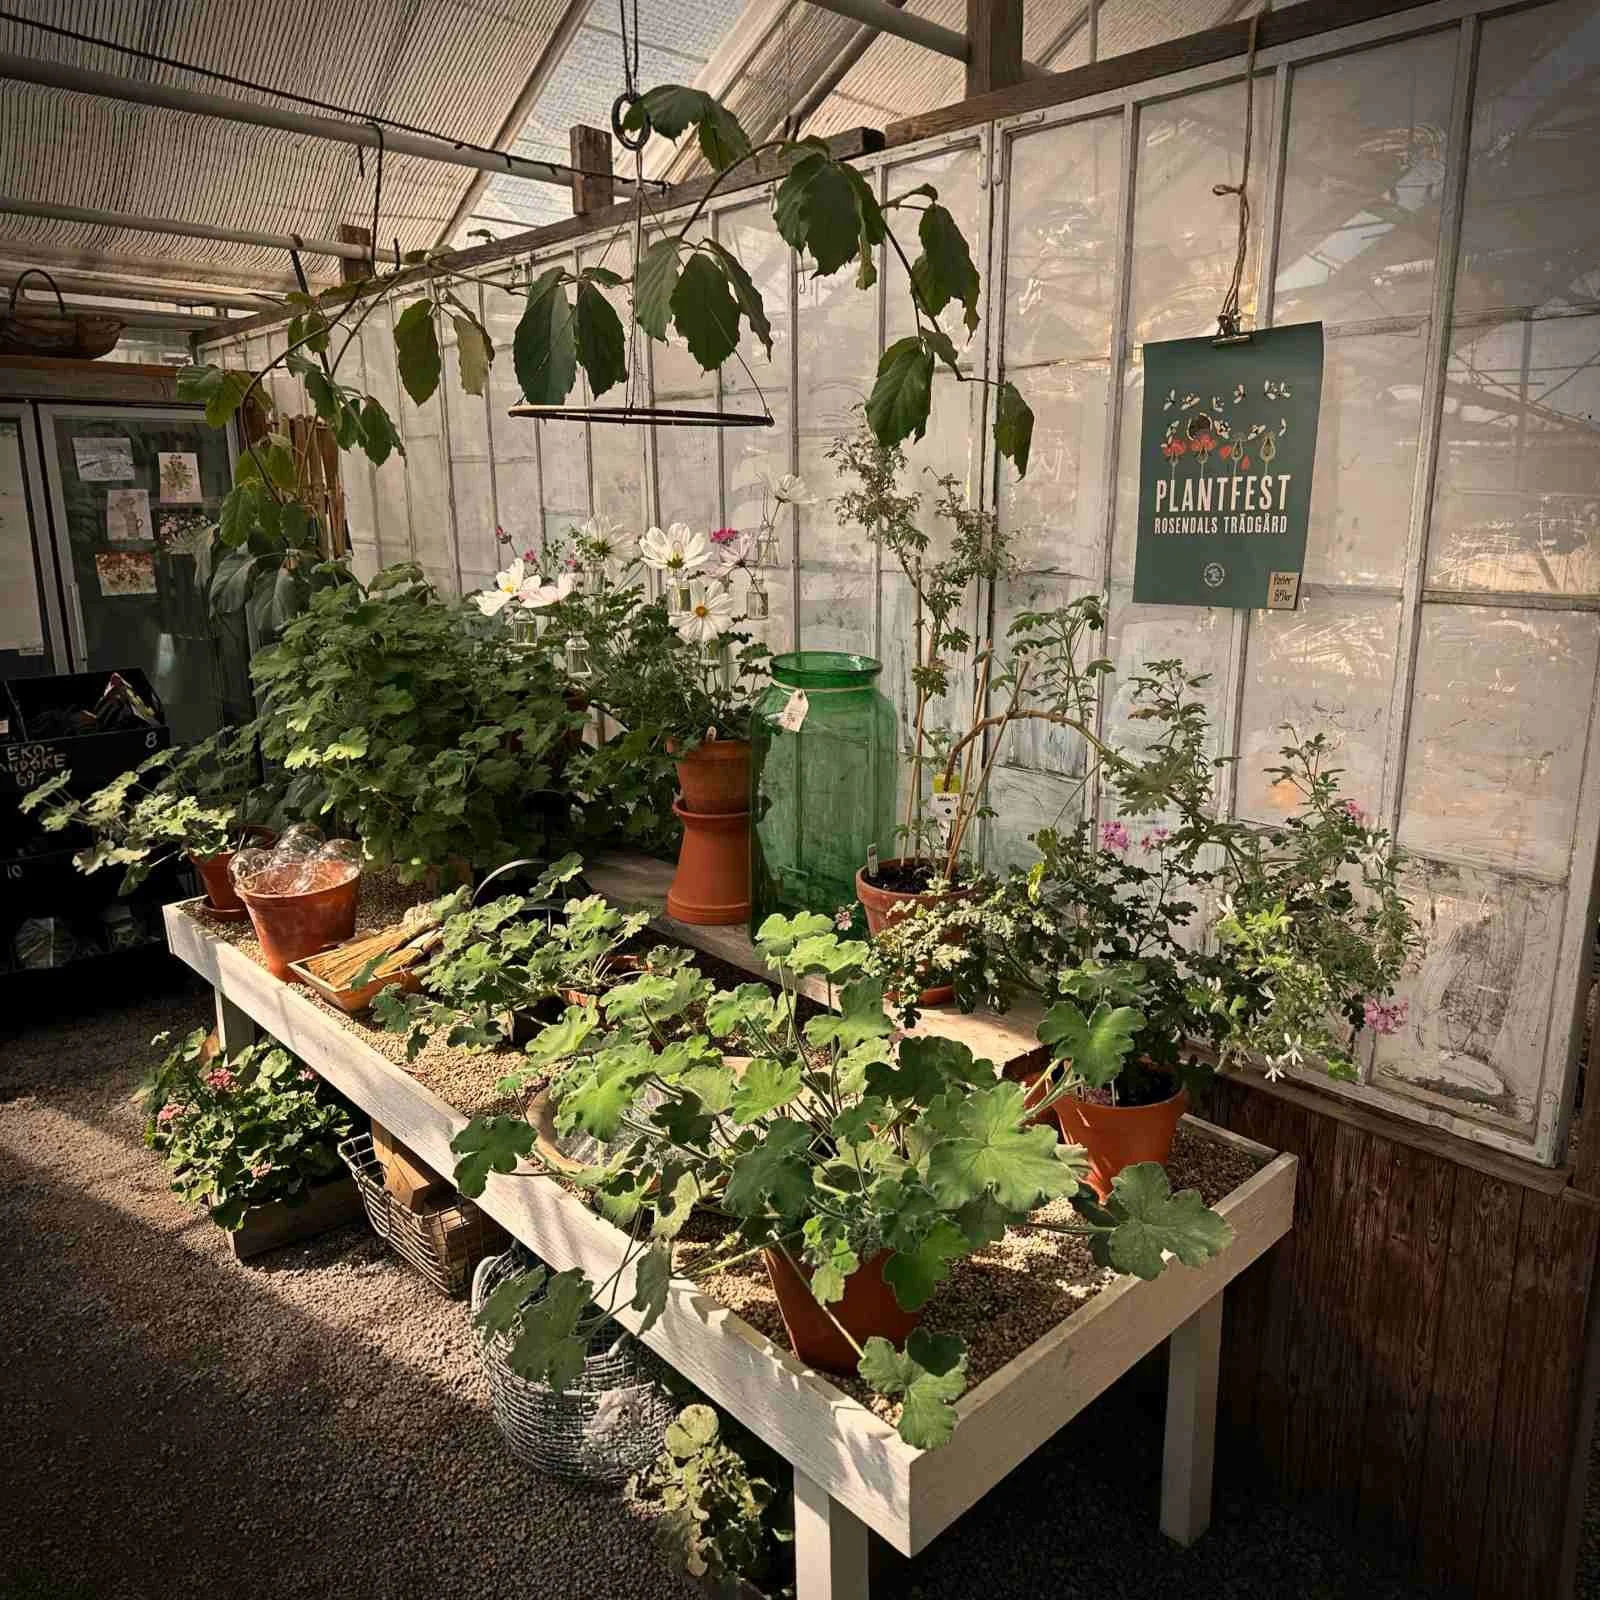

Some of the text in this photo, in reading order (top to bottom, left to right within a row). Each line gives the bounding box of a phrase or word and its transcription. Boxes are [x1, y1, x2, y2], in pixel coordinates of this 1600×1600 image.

[1155, 474, 1291, 512] PLANTFEST
[1154, 513, 1287, 534] ROSENDALS TRÄDGÅRD
[145, 731, 157, 748] 8
[7, 864, 23, 879] 10
